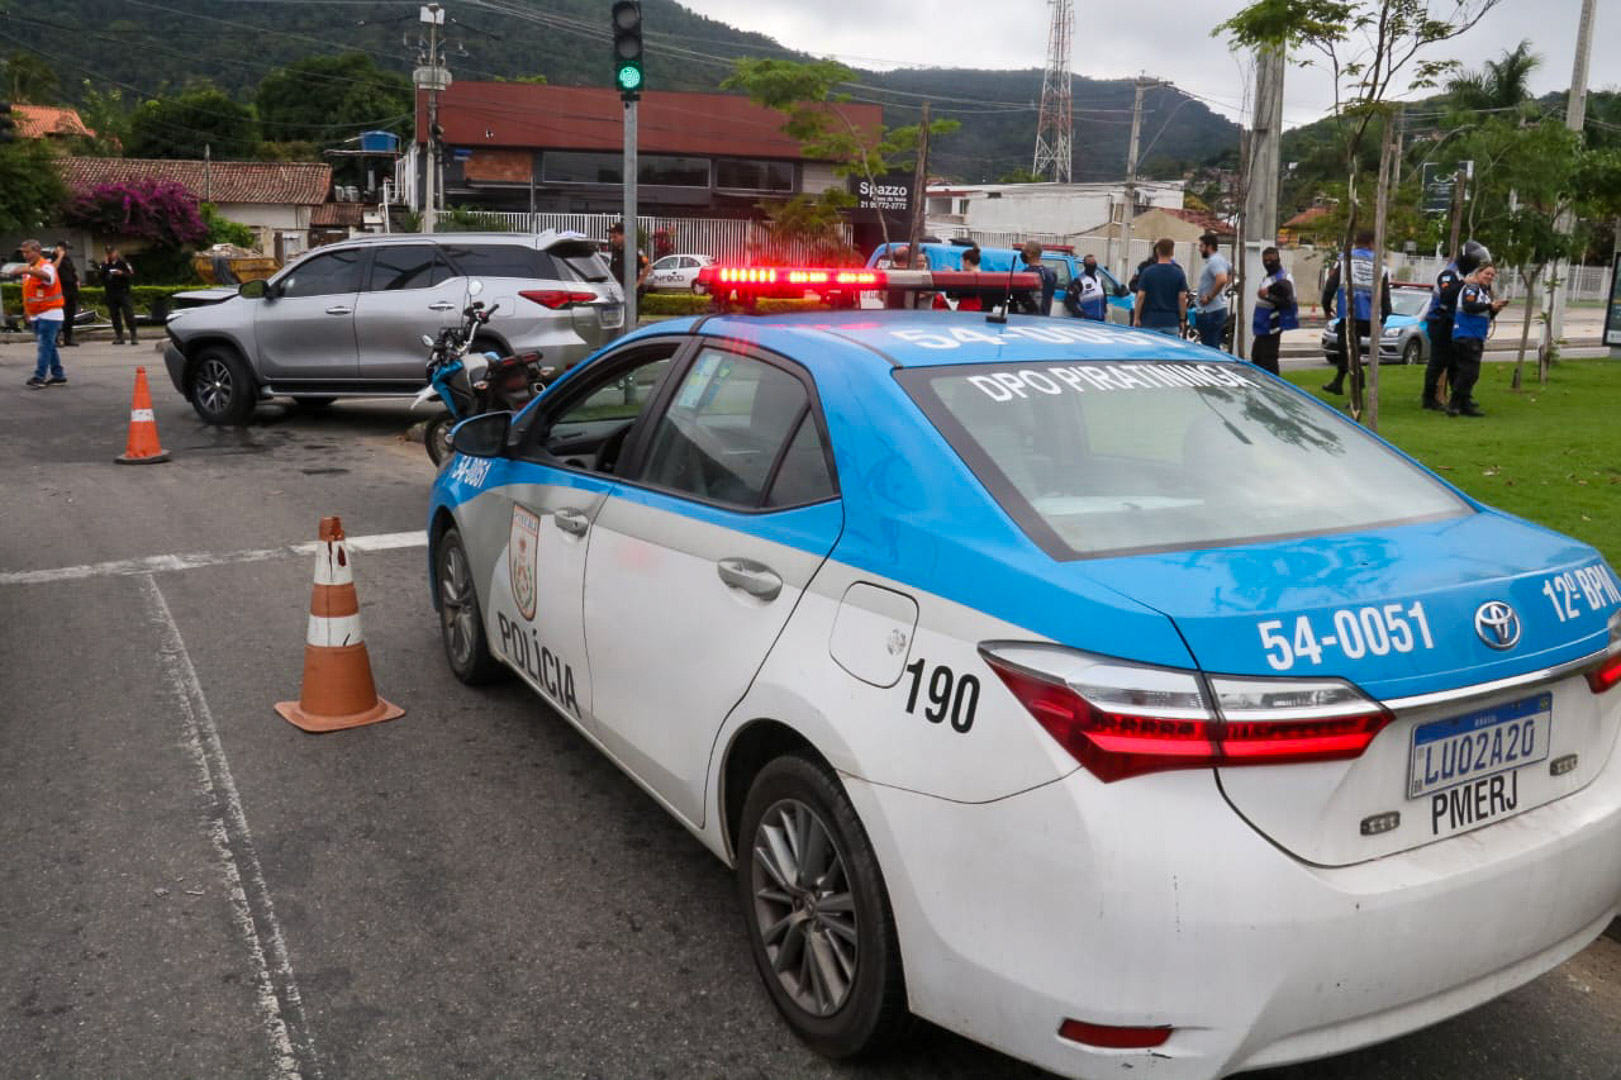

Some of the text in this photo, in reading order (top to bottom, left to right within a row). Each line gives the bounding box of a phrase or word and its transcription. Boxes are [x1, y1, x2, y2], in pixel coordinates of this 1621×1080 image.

[859, 181, 908, 197] Spazzo
[889, 325, 1186, 349] 54-0051
[967, 364, 1261, 402] DPO PIRATININGA
[1574, 564, 1621, 611] BPM
[1257, 600, 1435, 671] 54-0051
[497, 611, 582, 719] POLÍCIA
[905, 658, 981, 734] 190
[1432, 769, 1518, 835] PMERJ
